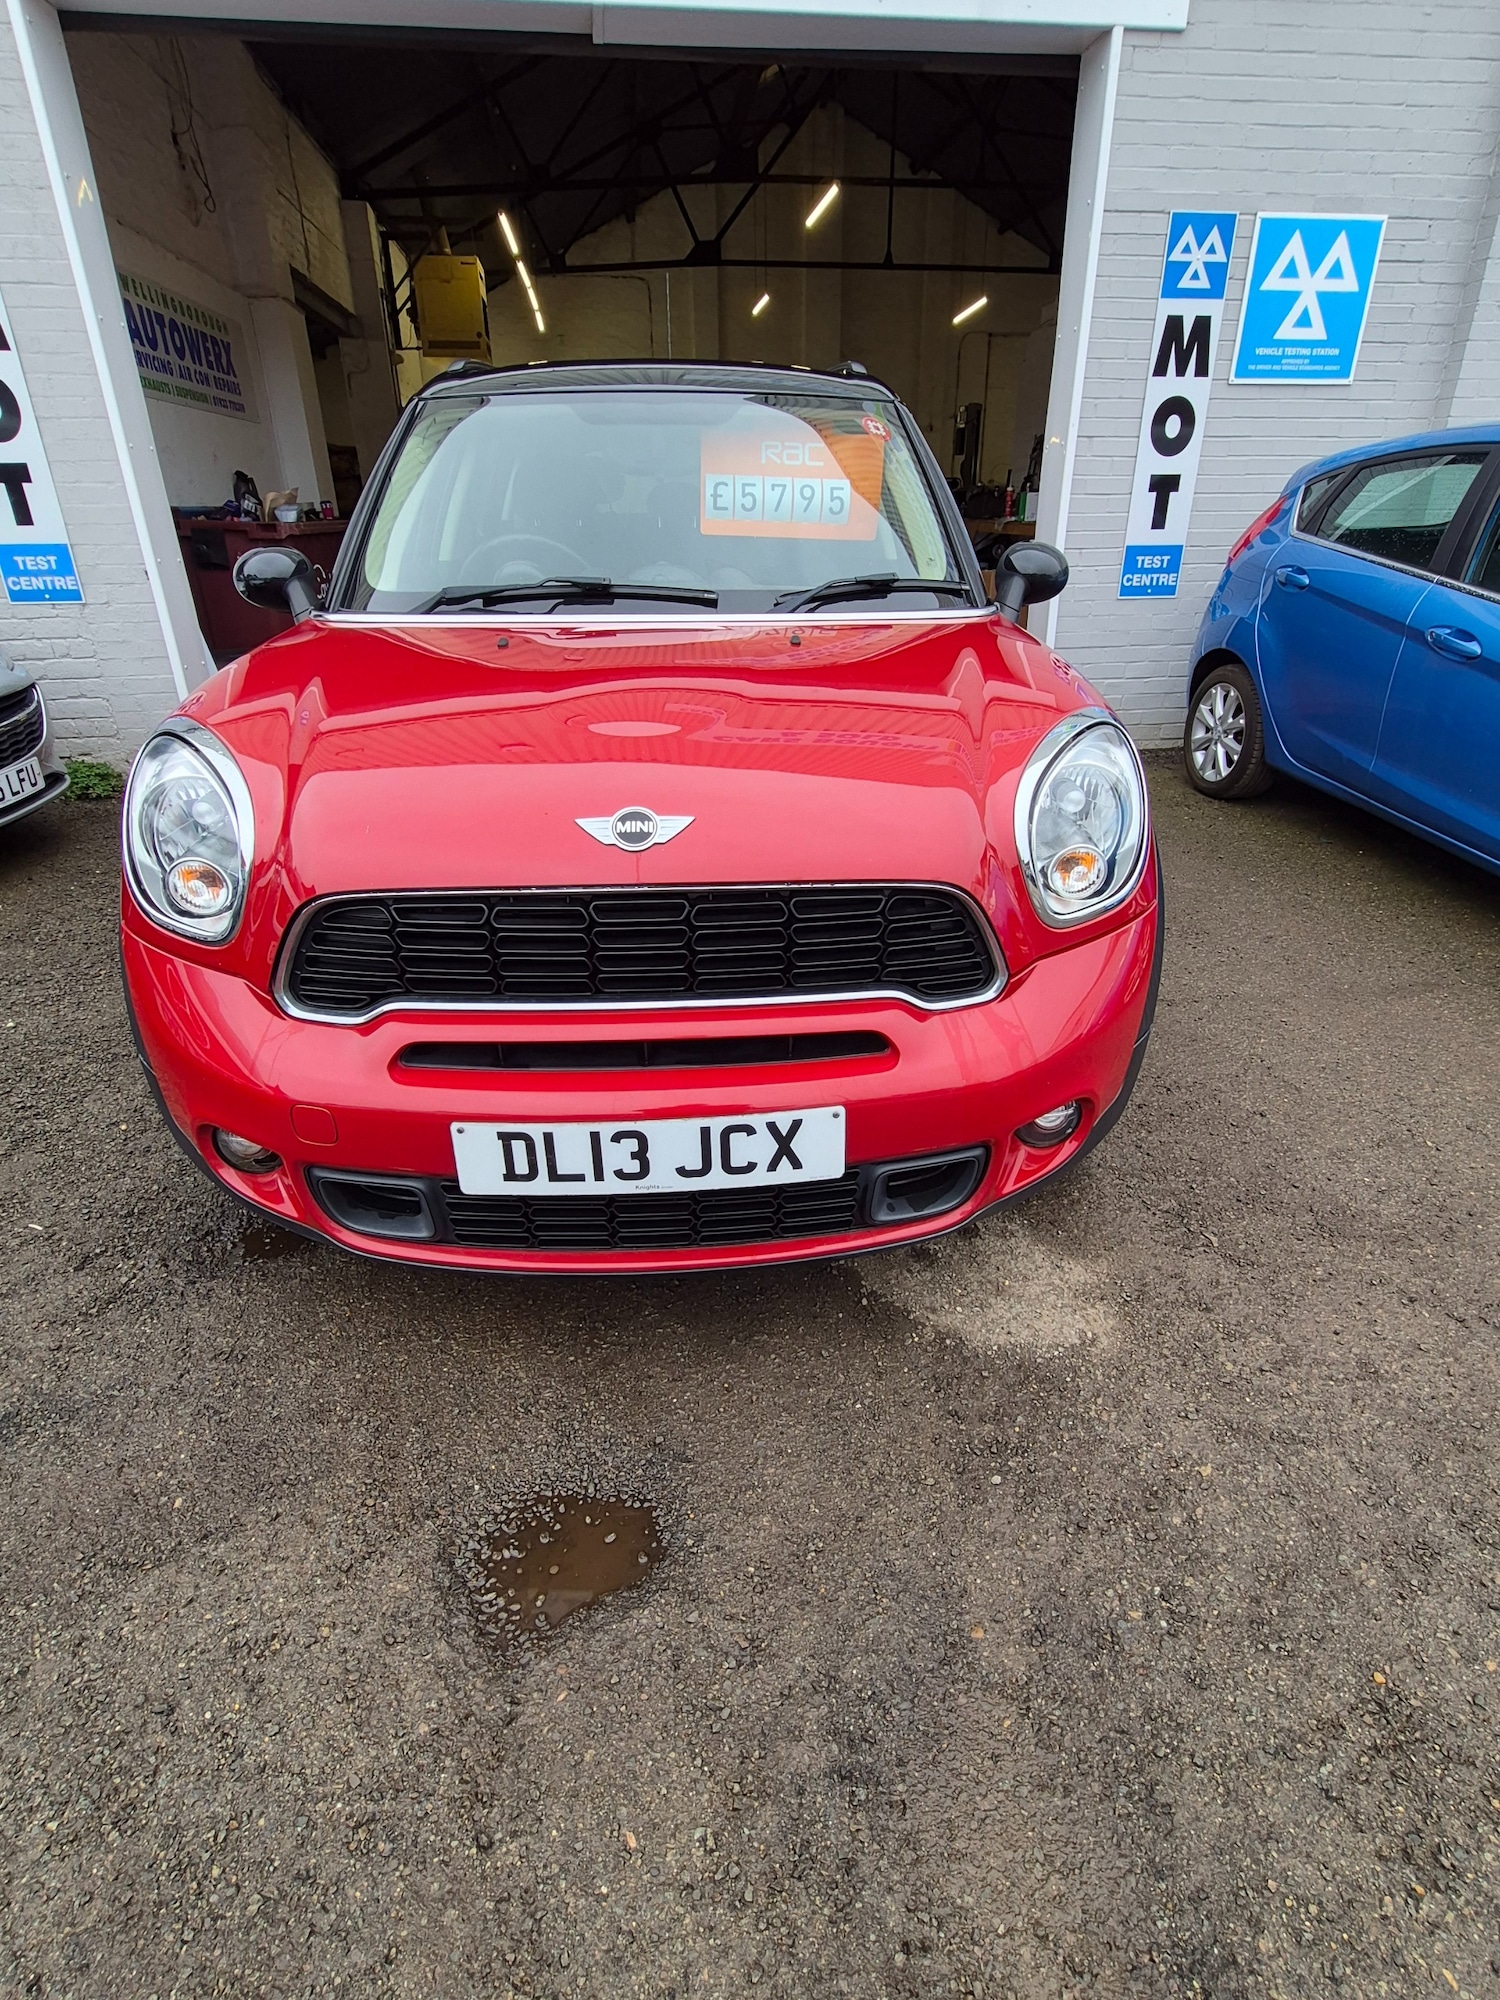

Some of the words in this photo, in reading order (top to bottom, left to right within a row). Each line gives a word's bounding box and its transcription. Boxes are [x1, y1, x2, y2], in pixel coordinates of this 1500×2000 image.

[119, 272, 230, 337] WELLINGBOROUGH
[124, 297, 238, 379] AUTOWERX
[1255, 347, 1283, 356] VEHICLE
[1284, 347, 1311, 356] TESTING
[1312, 348, 1340, 356] STATION
[135, 350, 174, 377] RVICING
[177, 363, 194, 383] AIR
[194, 369, 211, 388] CON
[213, 375, 242, 397] REPAIRS
[709, 480, 846, 516] £5795
[13, 555, 57, 570] TEST
[1135, 555, 1171, 569] TEST
[7, 576, 79, 592] CENTRE
[1122, 572, 1178, 587] CENTRE
[5, 764, 38, 797] LFU
[616, 820, 654, 834] MINI
[496, 1130, 650, 1183] DL13
[674, 1118, 804, 1179] JCX
